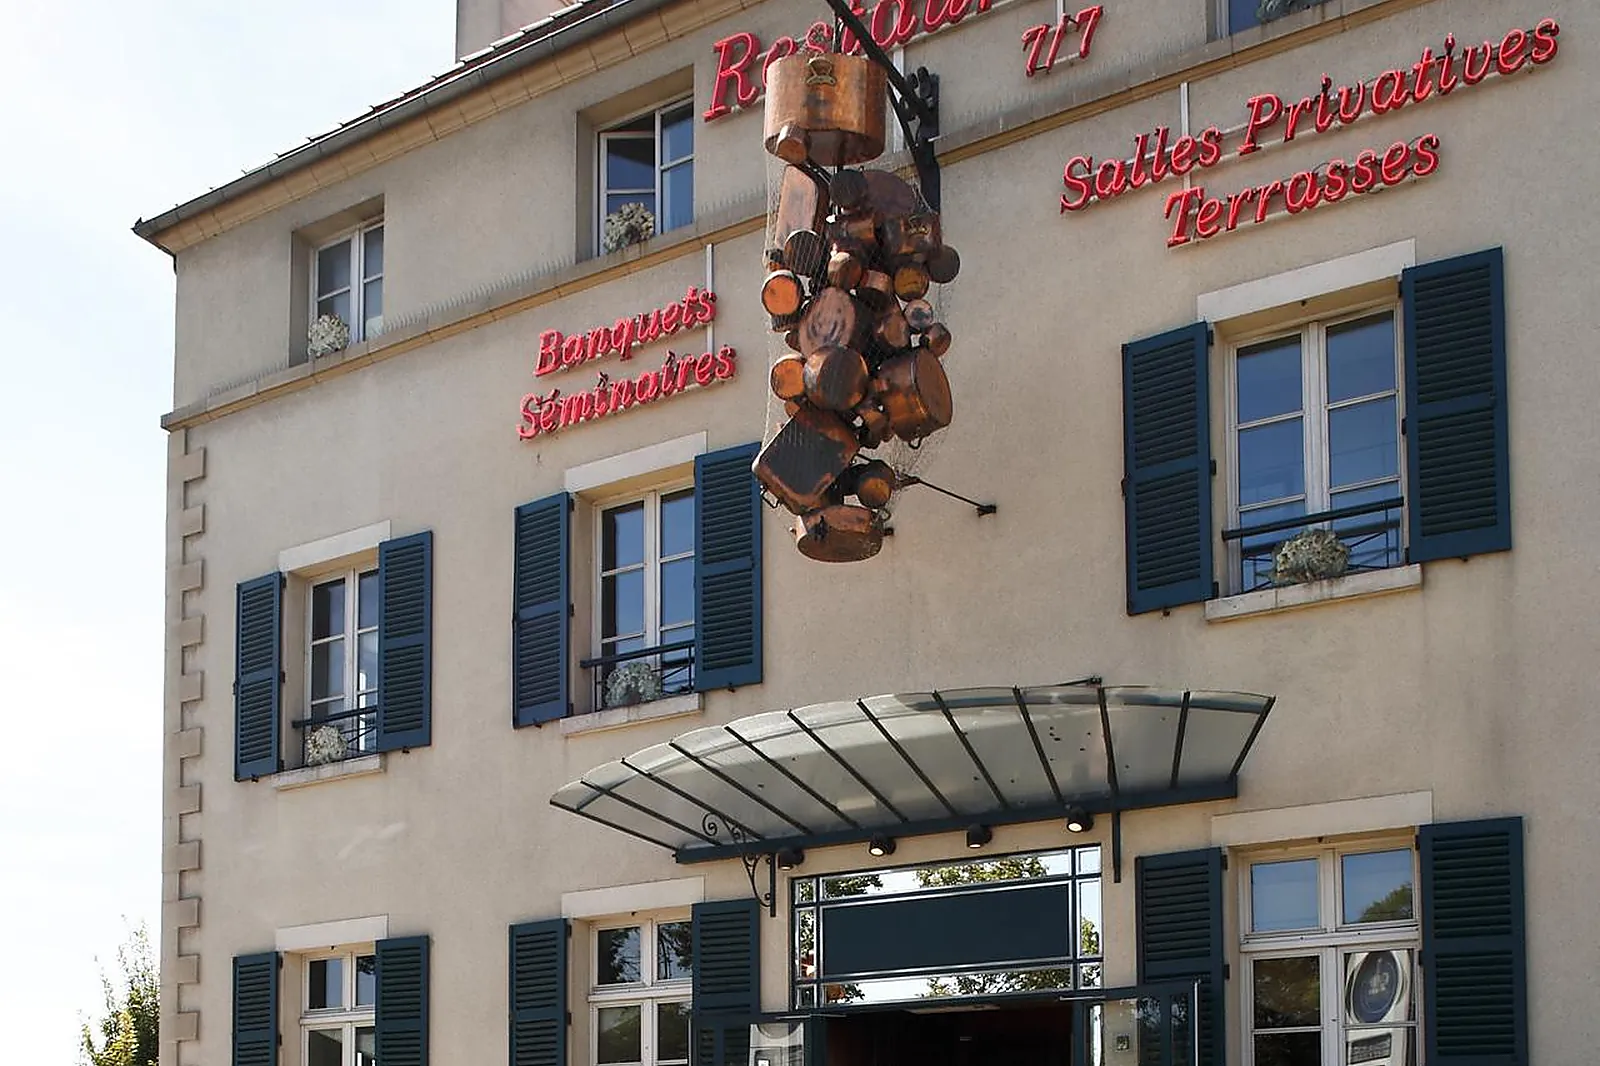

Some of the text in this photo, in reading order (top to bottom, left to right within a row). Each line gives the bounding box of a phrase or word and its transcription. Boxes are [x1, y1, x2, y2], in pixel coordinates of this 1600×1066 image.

[703, 0, 993, 121] Restau
[1060, 18, 1560, 213] Salles Privatives
[1164, 133, 1440, 248] Terrasses
[533, 285, 717, 377] Banquets
[516, 344, 737, 441] Séminaires
